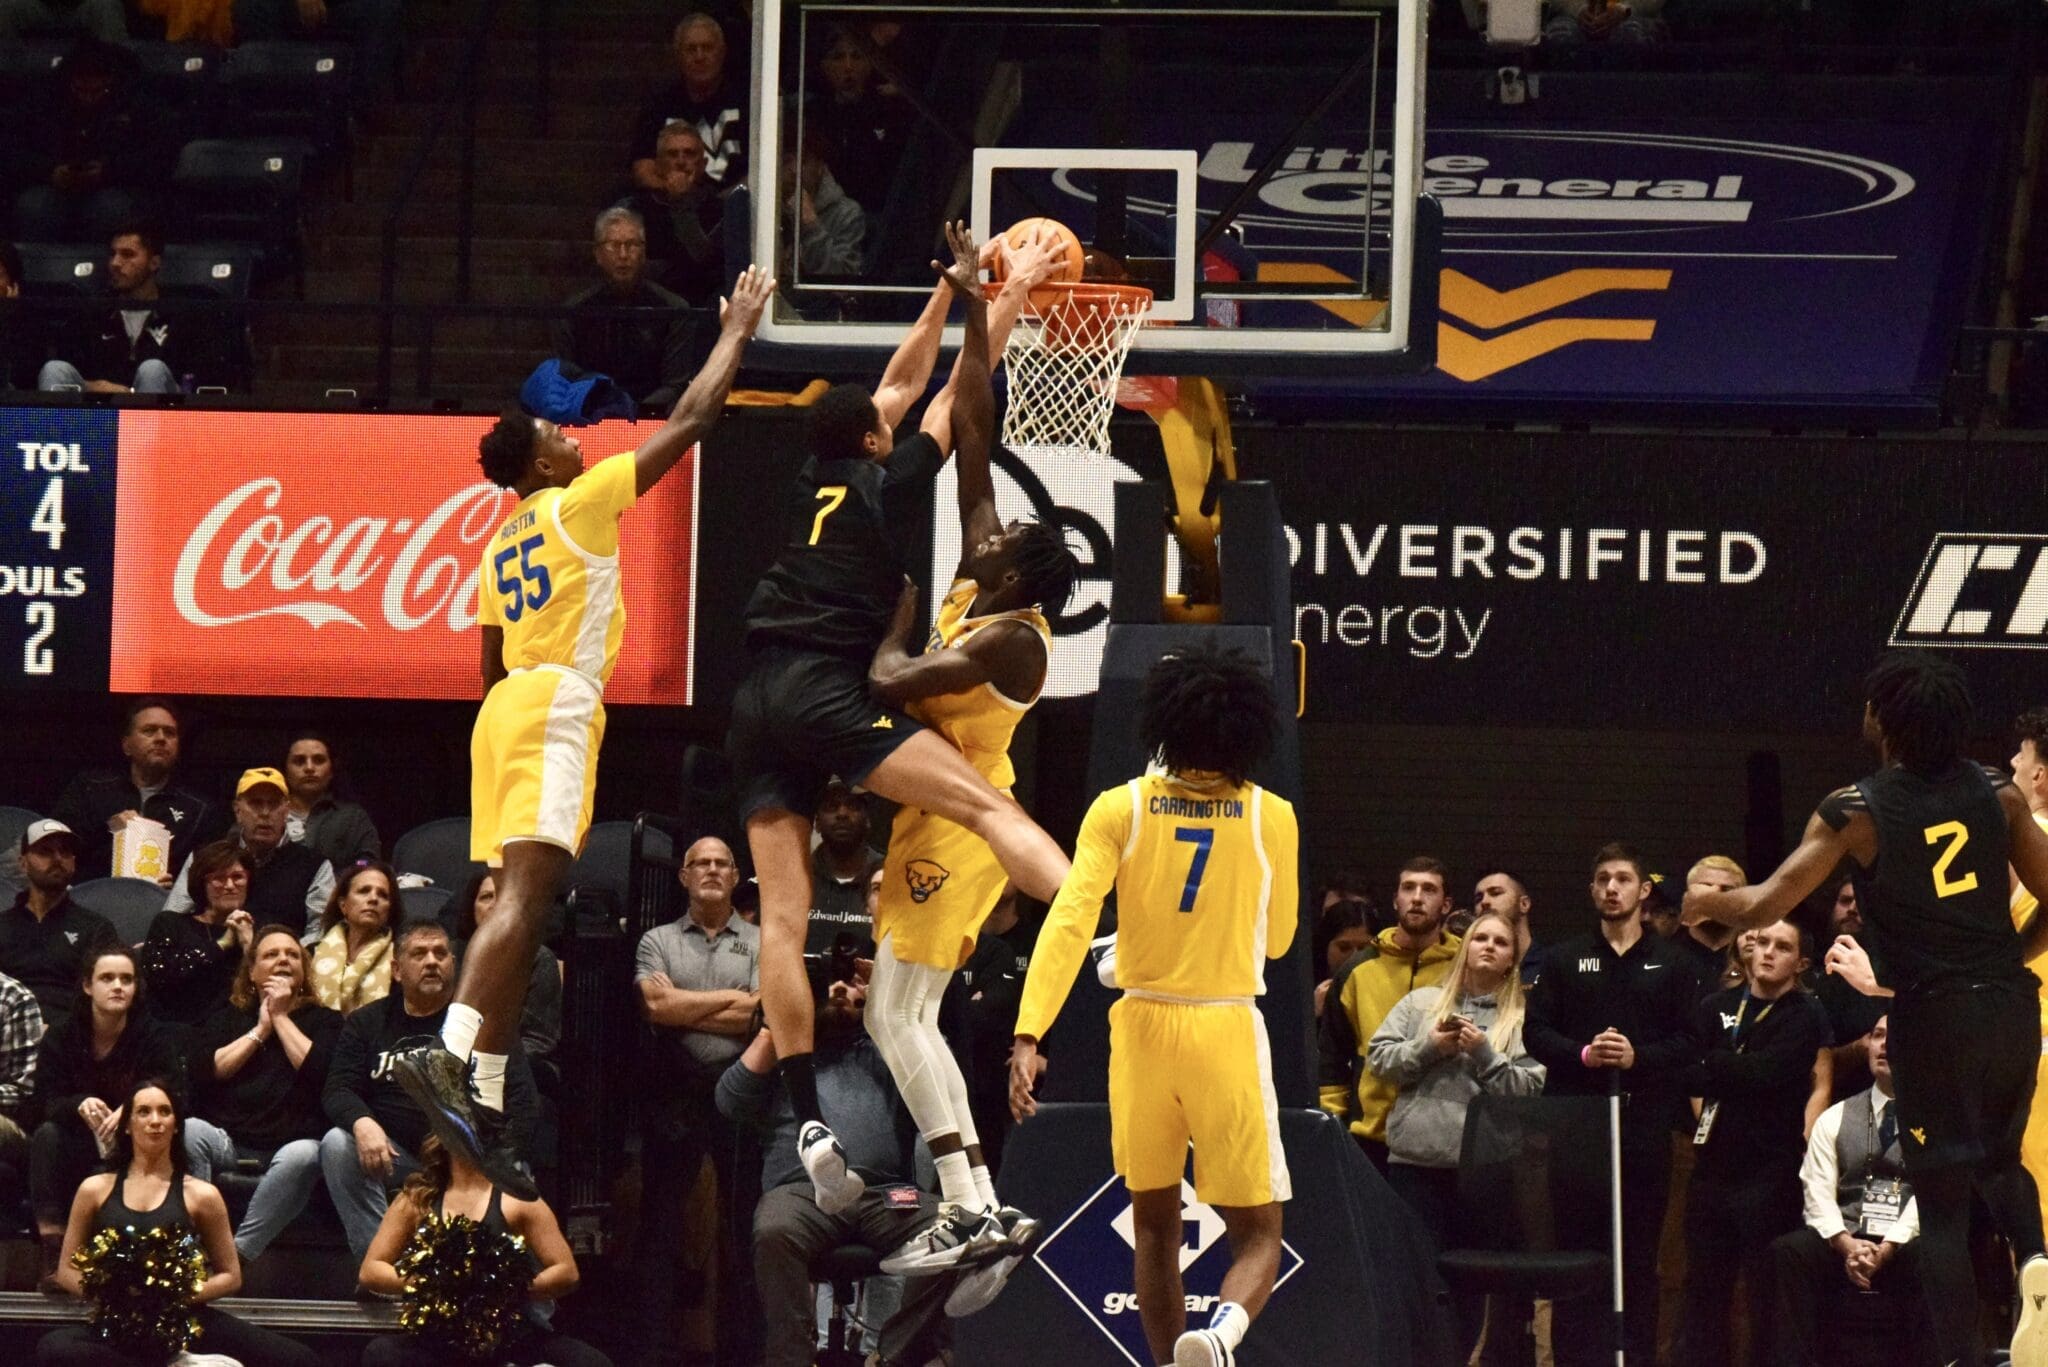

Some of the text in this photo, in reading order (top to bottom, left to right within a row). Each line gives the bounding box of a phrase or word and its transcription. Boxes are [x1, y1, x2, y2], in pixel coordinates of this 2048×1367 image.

[1198, 142, 1490, 183] Litte
[17, 442, 90, 472] TOL
[31, 475, 66, 550] 4
[501, 509, 536, 540] AUSTIN
[808, 486, 847, 546] 7
[0, 565, 87, 597] OULS
[494, 532, 552, 623] 55
[24, 601, 56, 676] 2
[1294, 602, 1493, 659] nergy
[1149, 795, 1243, 819] CARRINGTON
[1174, 827, 1215, 913] 7
[1923, 820, 1978, 898] 2
[807, 909, 843, 922] Edward
